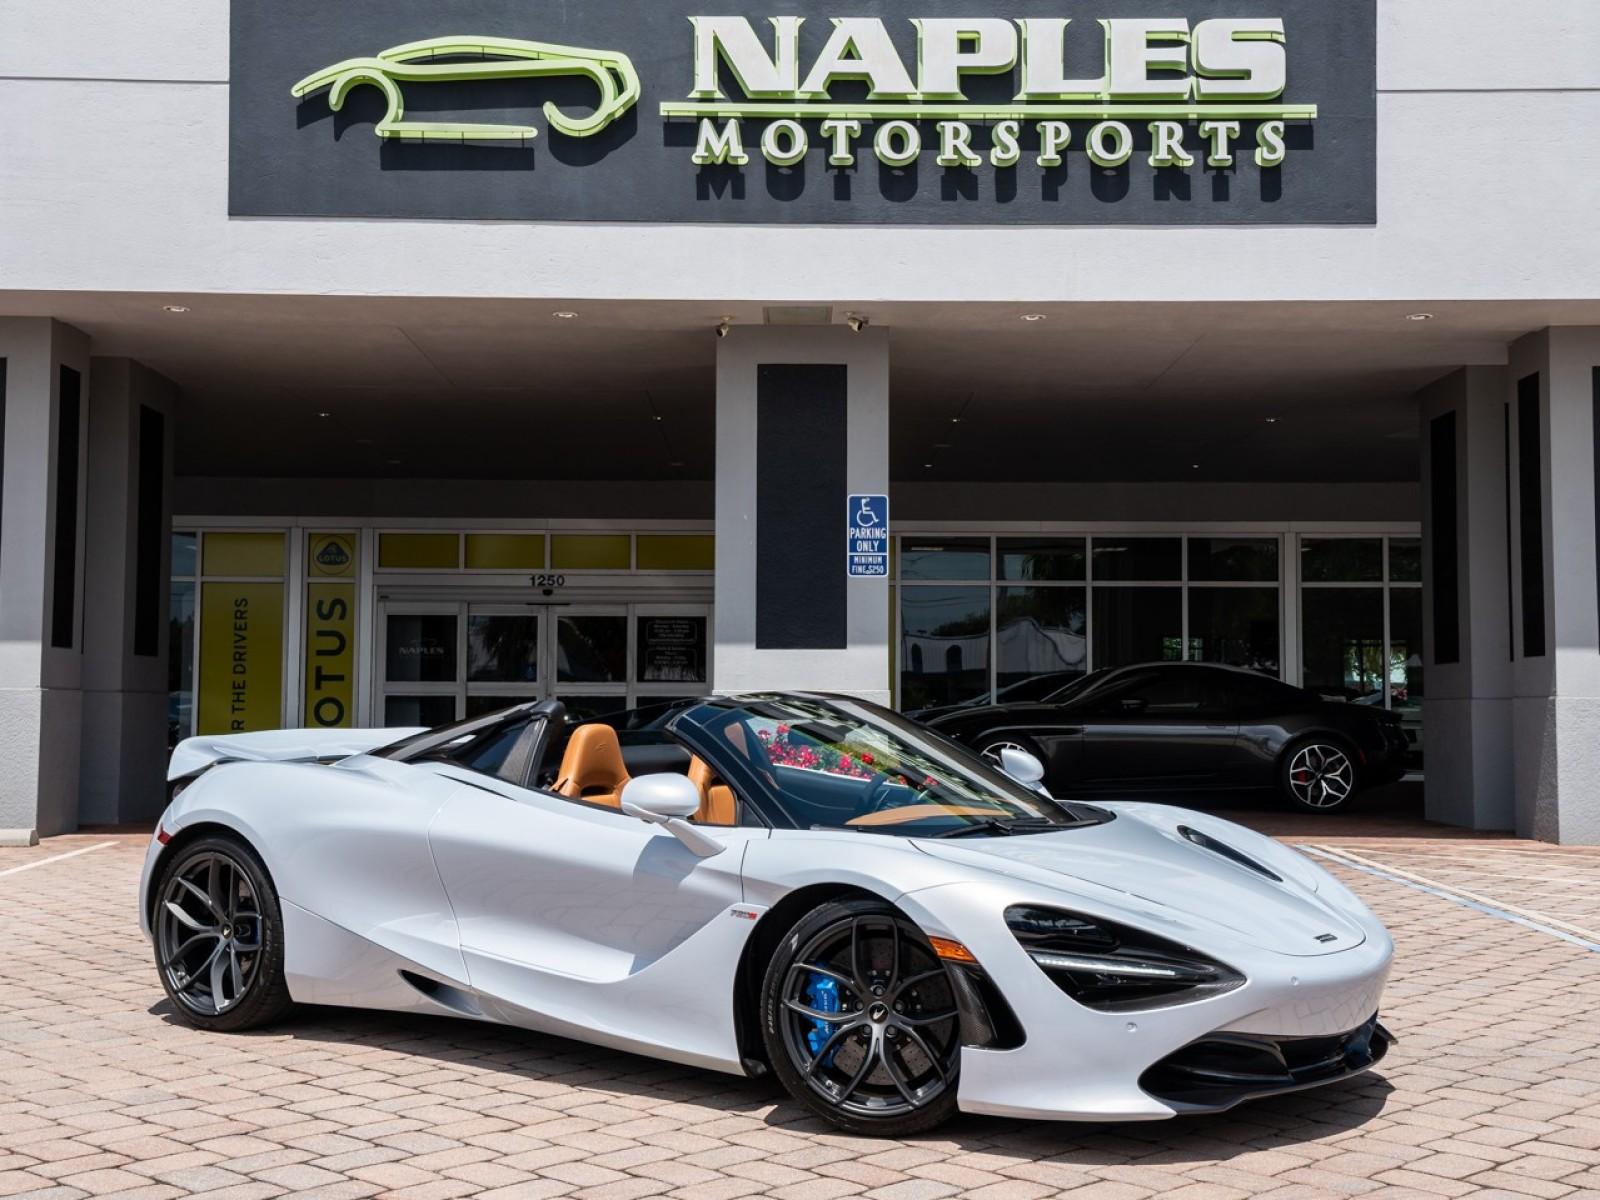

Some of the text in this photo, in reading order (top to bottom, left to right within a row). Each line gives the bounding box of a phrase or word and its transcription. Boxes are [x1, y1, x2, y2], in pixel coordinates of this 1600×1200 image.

[687, 15, 1287, 100] NAPLES
[692, 118, 1286, 166] MOTORSPORTS
[850, 528, 886, 539] PARKING
[857, 541, 880, 552] ONLY
[318, 554, 347, 563] LOTUS
[854, 556, 883, 564] MINIMUM
[852, 565, 866, 574] FINE
[529, 575, 565, 587] 1250
[232, 597, 249, 675] DRIVERS
[399, 647, 445, 655] NAPLES
[313, 597, 347, 727] OTUS
[231, 680, 246, 714] THE
